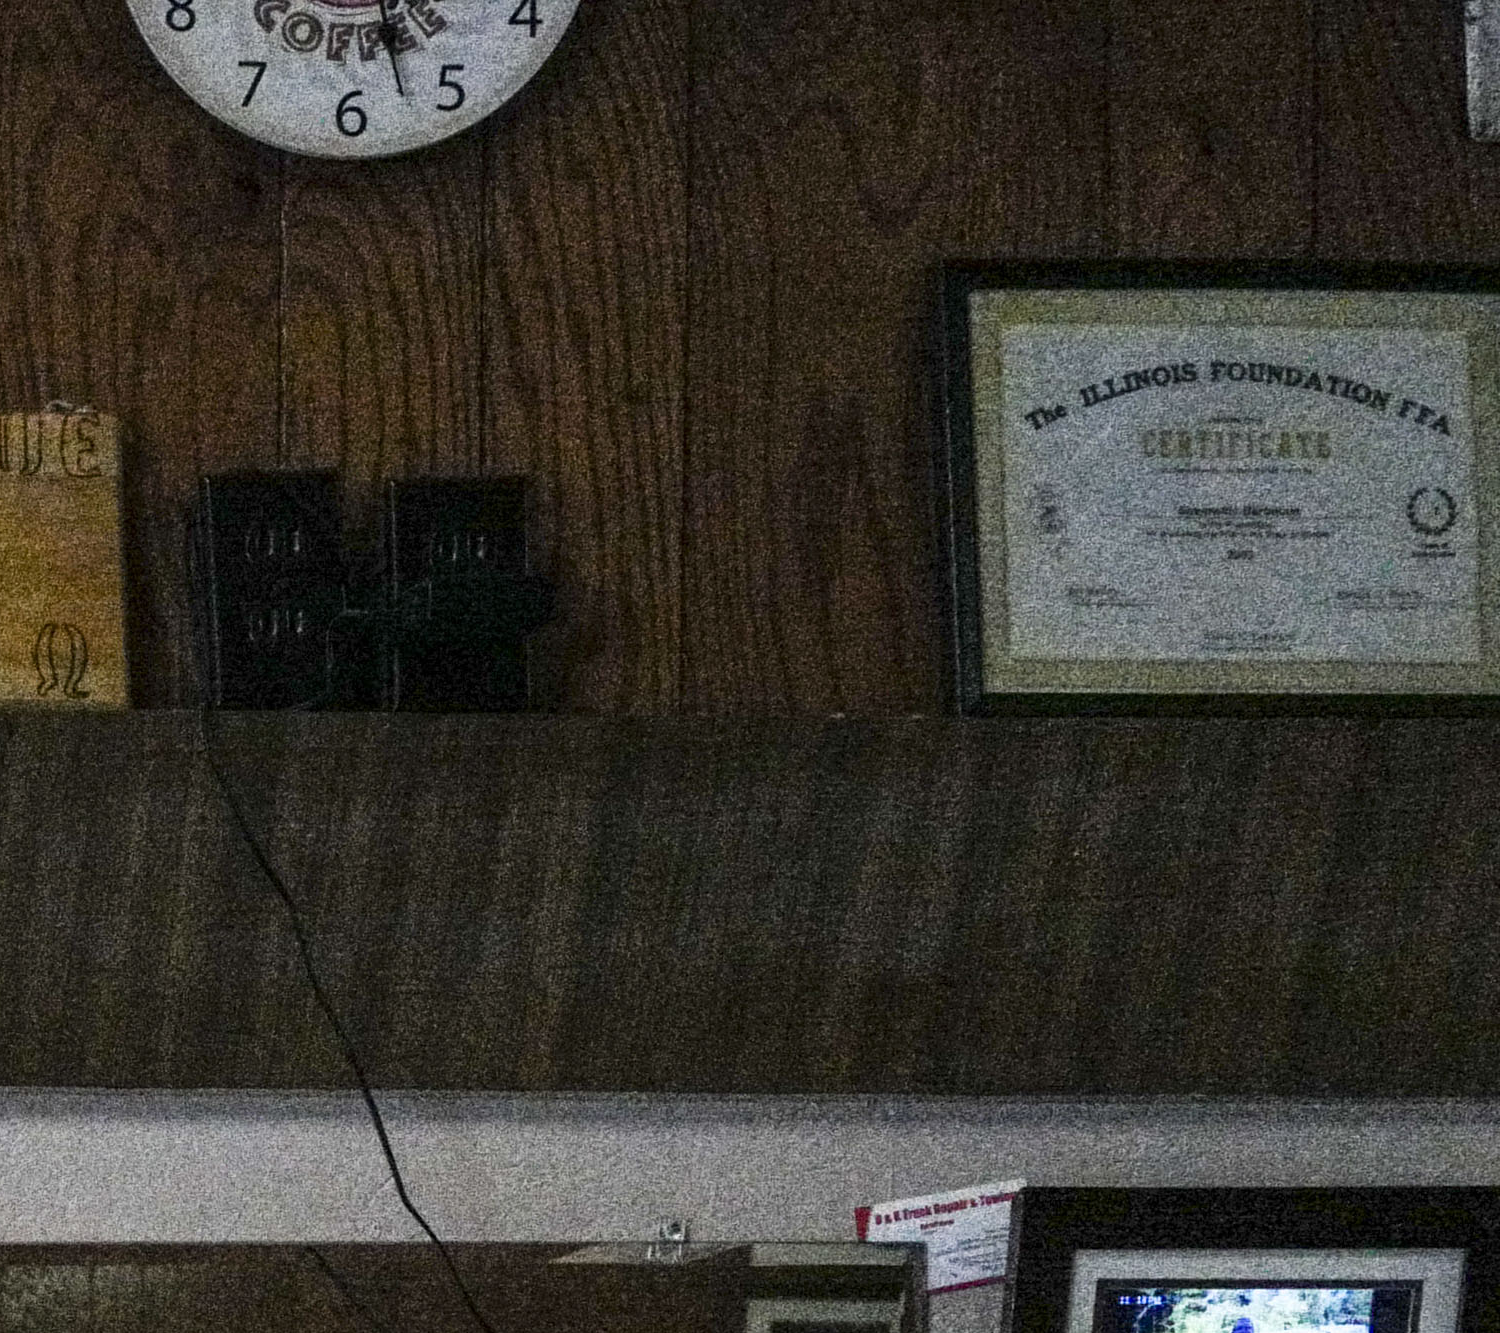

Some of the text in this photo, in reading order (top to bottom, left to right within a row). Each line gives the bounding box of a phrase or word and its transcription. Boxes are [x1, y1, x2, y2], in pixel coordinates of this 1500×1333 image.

[165, 0, 197, 32] 8
[237, 60, 268, 107] 7
[436, 64, 467, 111] 5
[334, 90, 368, 137] 6
[1024, 360, 1453, 437] The ILLINOIS FOUNDATION FFA
[1140, 428, 1333, 461] CERTIFICATE
